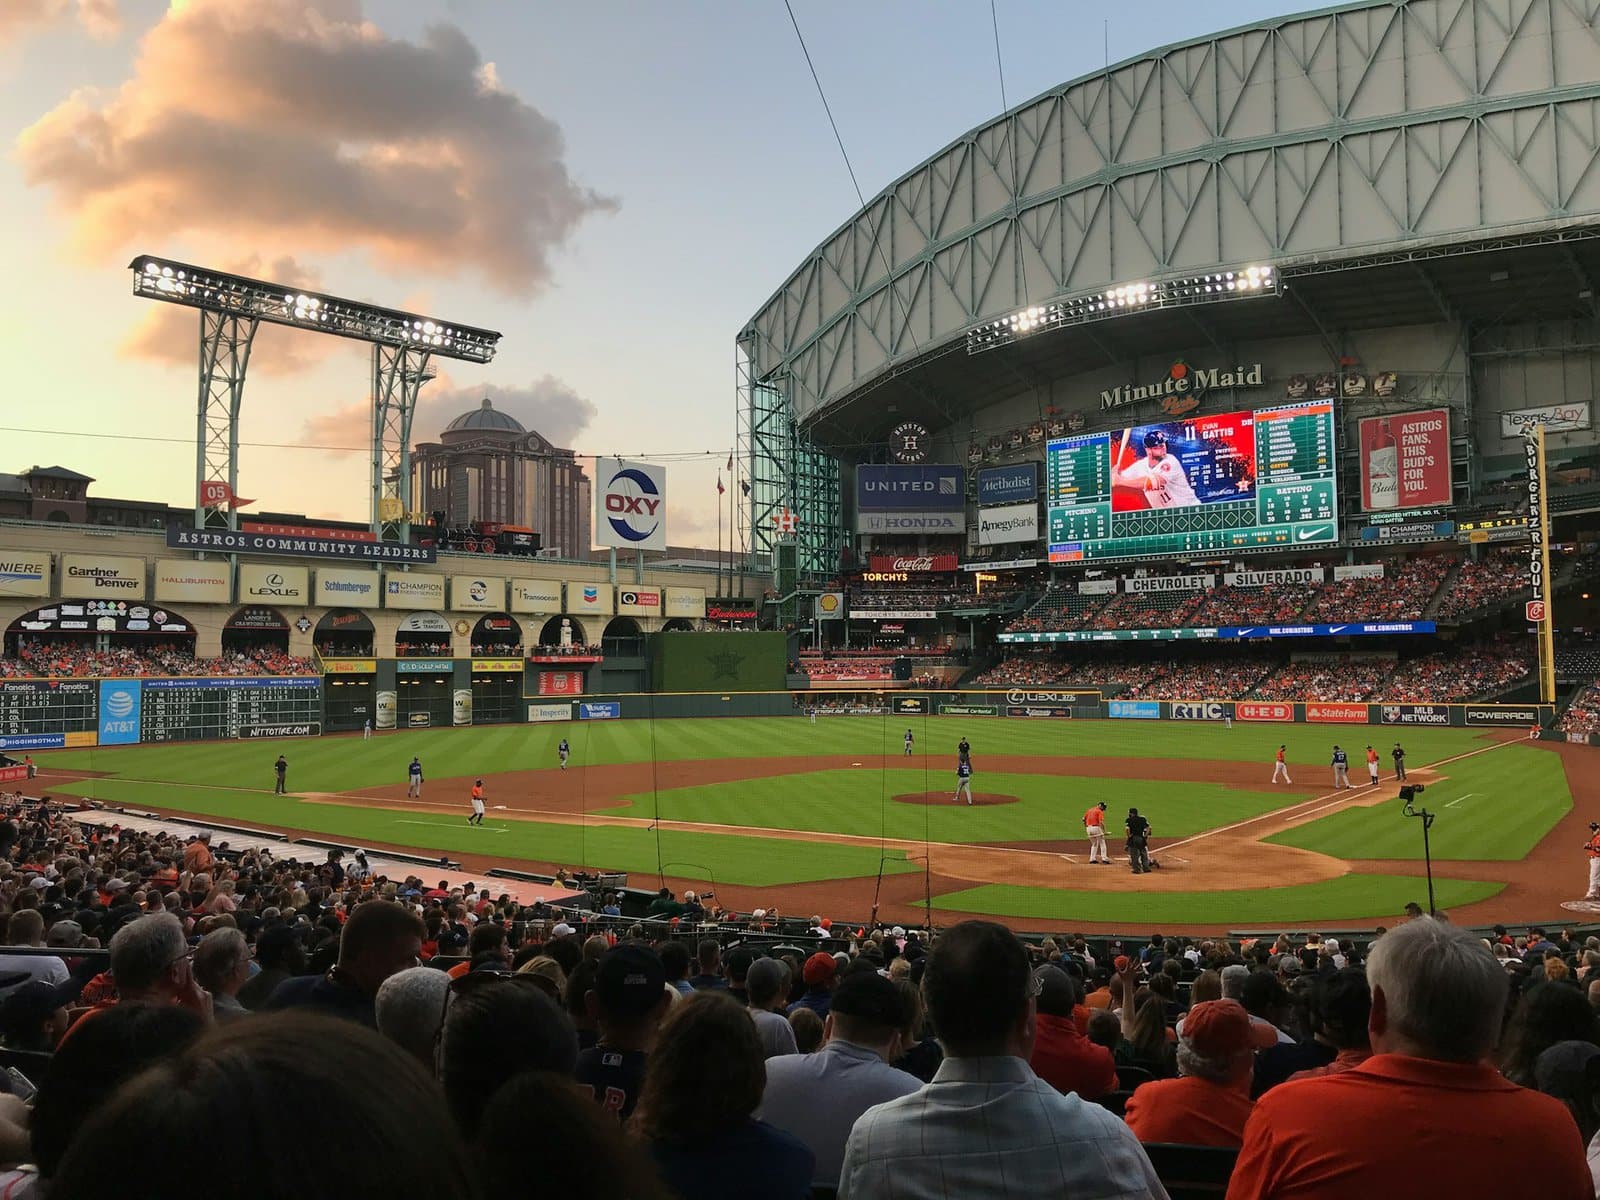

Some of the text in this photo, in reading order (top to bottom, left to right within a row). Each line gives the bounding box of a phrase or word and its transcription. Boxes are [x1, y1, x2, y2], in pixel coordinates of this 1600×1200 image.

[1100, 378, 1188, 410] Minute
[1195, 364, 1263, 389] Maid
[1402, 420, 1442, 434] ASTROS
[1185, 426, 1196, 441] 11
[1203, 428, 1234, 439] GATTIS
[1402, 434, 1431, 446] FANS.
[1403, 445, 1425, 457] THIS
[1403, 456, 1434, 469] BUD'S
[1404, 469, 1423, 480] FOR
[865, 481, 934, 491] UNITED
[982, 476, 1031, 491] Methodist
[1404, 481, 1428, 491] YOU.
[208, 486, 225, 499] 05
[1276, 486, 1312, 494] BATTING
[1160, 492, 1171, 503] 11
[606, 494, 660, 516] OXY
[887, 518, 954, 527] HONDA
[1391, 524, 1434, 532] CHAMPION
[1488, 530, 1520, 540] generation
[254, 538, 357, 555] COMMUNITY
[363, 546, 428, 559] LEADERS
[68, 566, 119, 577] Gardner
[863, 573, 908, 581] TORCHYS
[95, 578, 139, 588] Denver
[161, 577, 225, 585] HALLIBURTON
[1133, 577, 1206, 590] CHEVROLET
[1236, 571, 1313, 585] SILVERADO
[250, 588, 299, 596] LEXUS
[325, 581, 371, 593] Schlumberger
[400, 583, 442, 592] CHAMPION
[523, 593, 559, 601] Transocean
[1172, 703, 1222, 718] RTIC
[1402, 714, 1446, 722] NETWORK
[104, 720, 135, 733] AT&T
[250, 726, 310, 736] NITTOTIRE.COM
